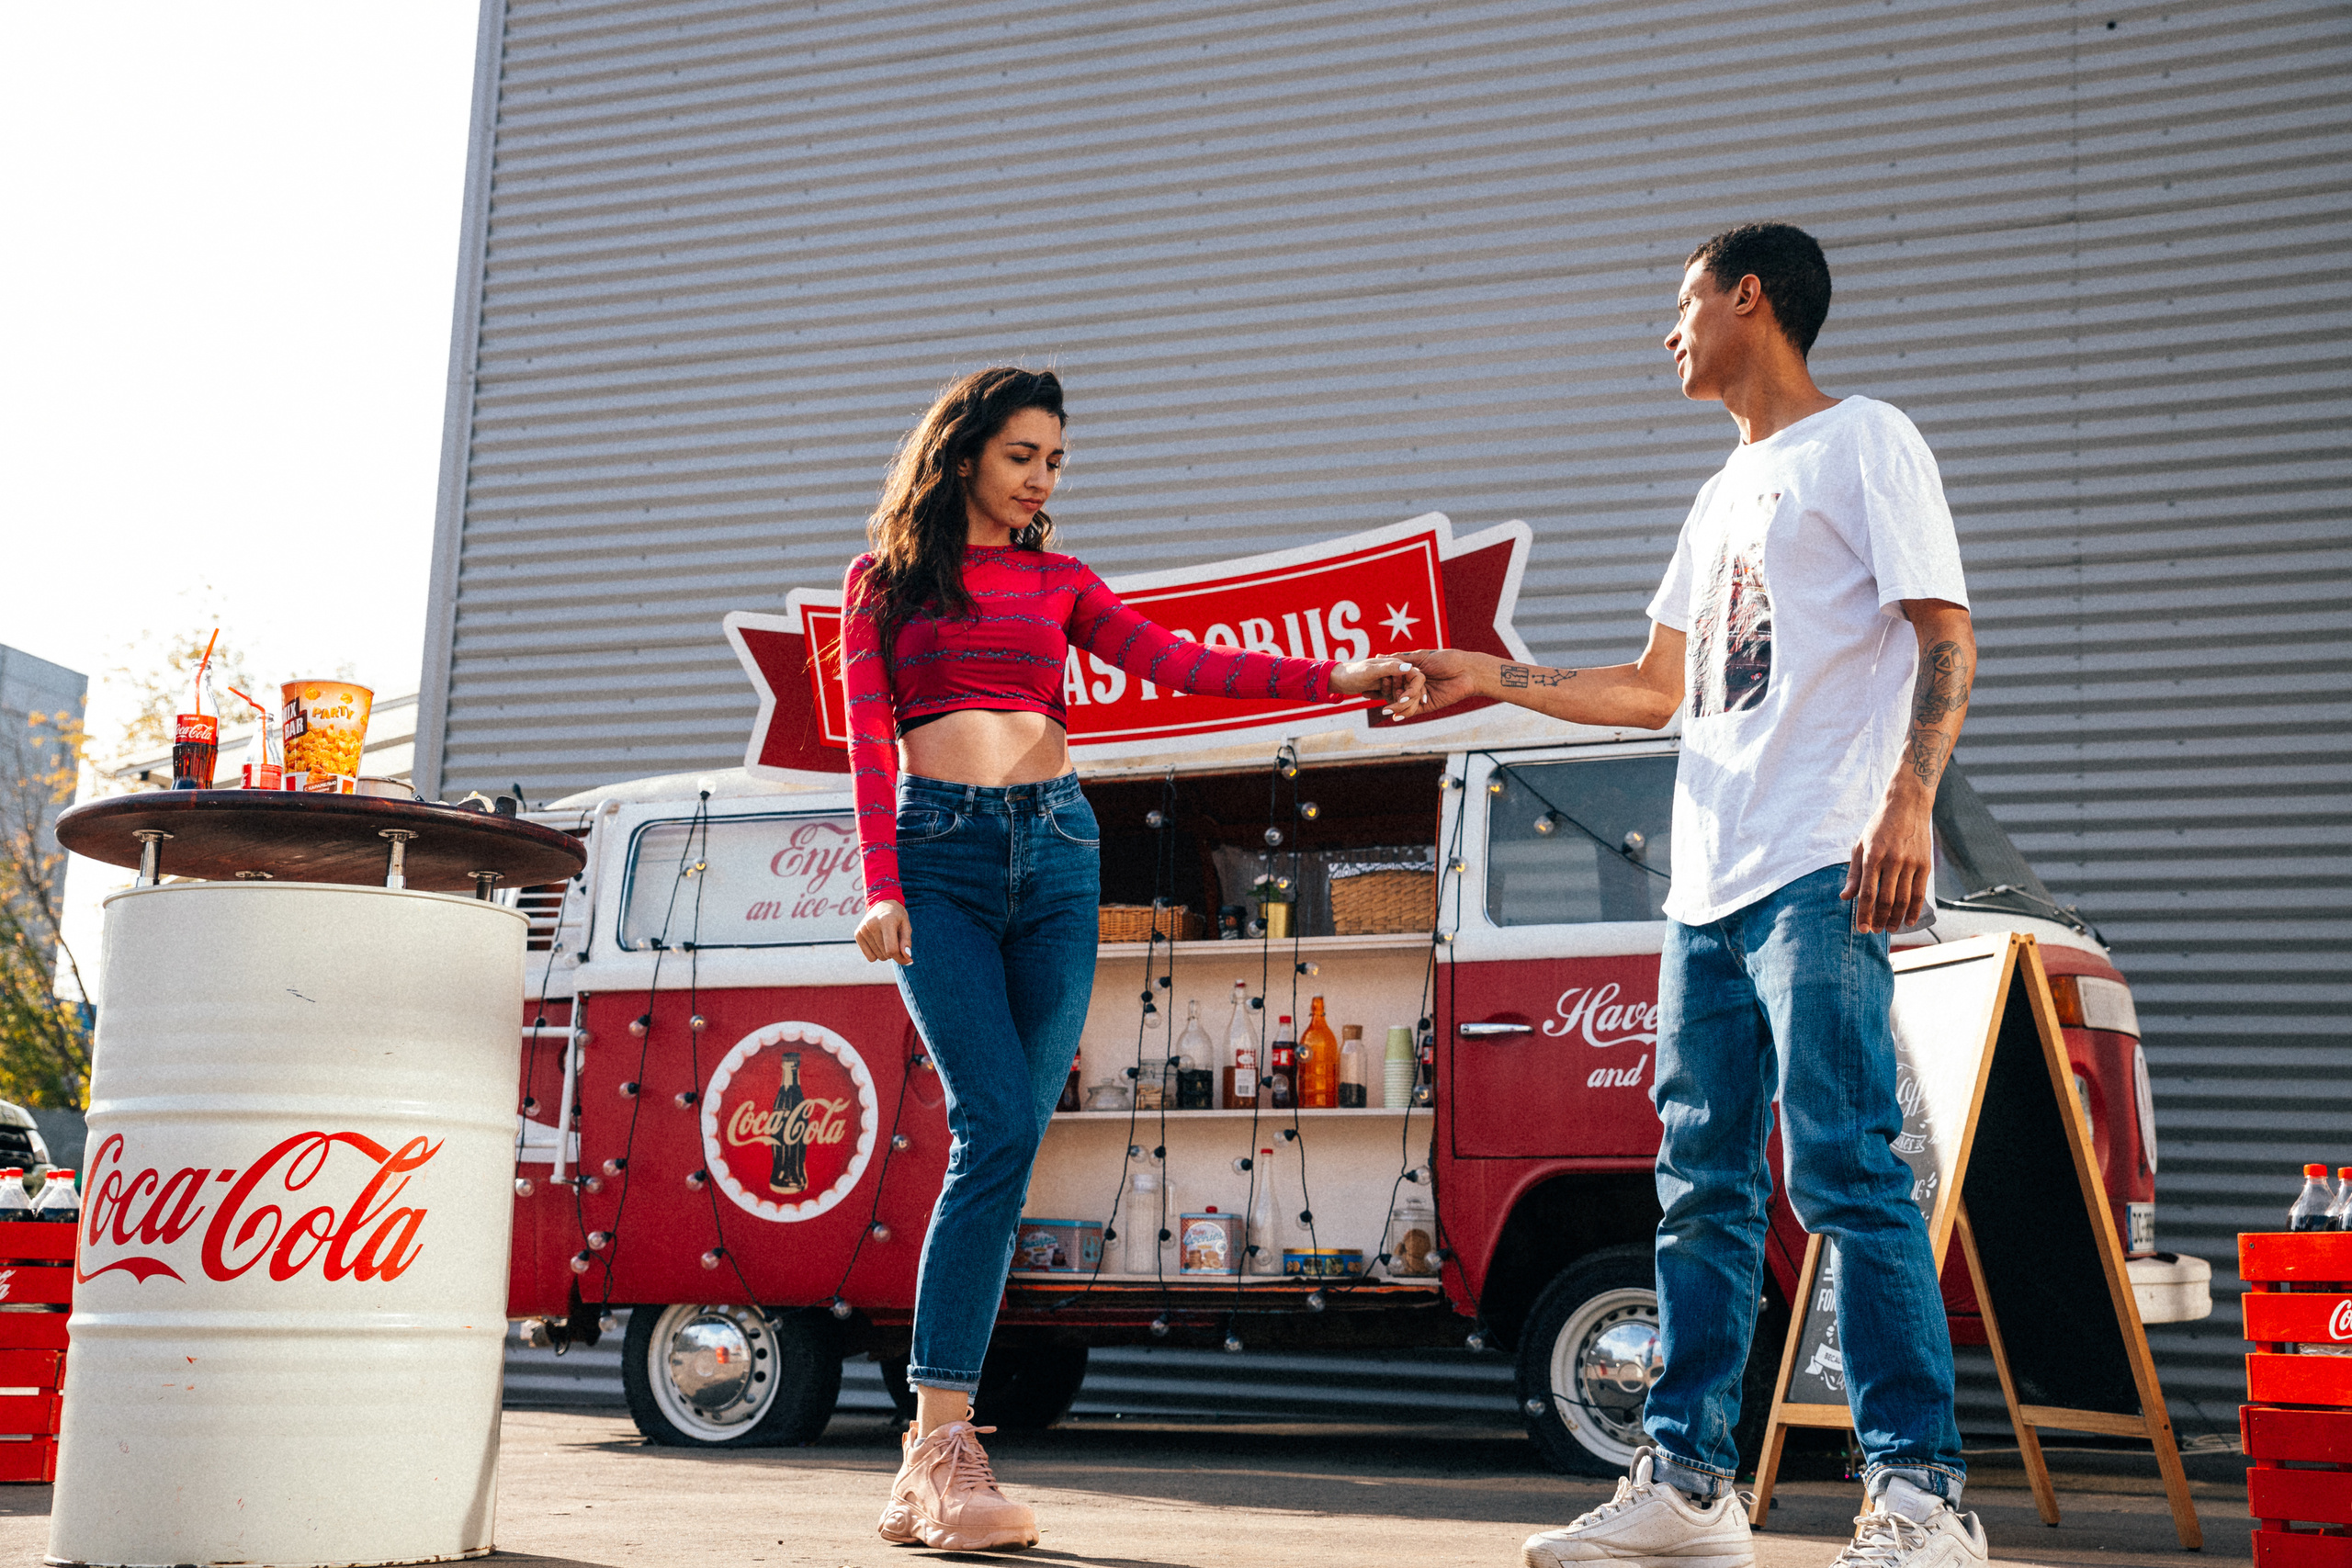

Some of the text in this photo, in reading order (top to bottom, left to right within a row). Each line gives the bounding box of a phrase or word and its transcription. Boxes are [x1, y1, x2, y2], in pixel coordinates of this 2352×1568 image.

[285, 717, 304, 740] BAR
[312, 705, 355, 720] PARTY
[770, 822, 865, 895] Enjo
[745, 893, 866, 921] an ice-co
[1542, 982, 1658, 1048] Have
[1587, 1054, 1648, 1088] and
[727, 1097, 852, 1147] Coca-Cola
[75, 1131, 446, 1285] Coca-Cola
